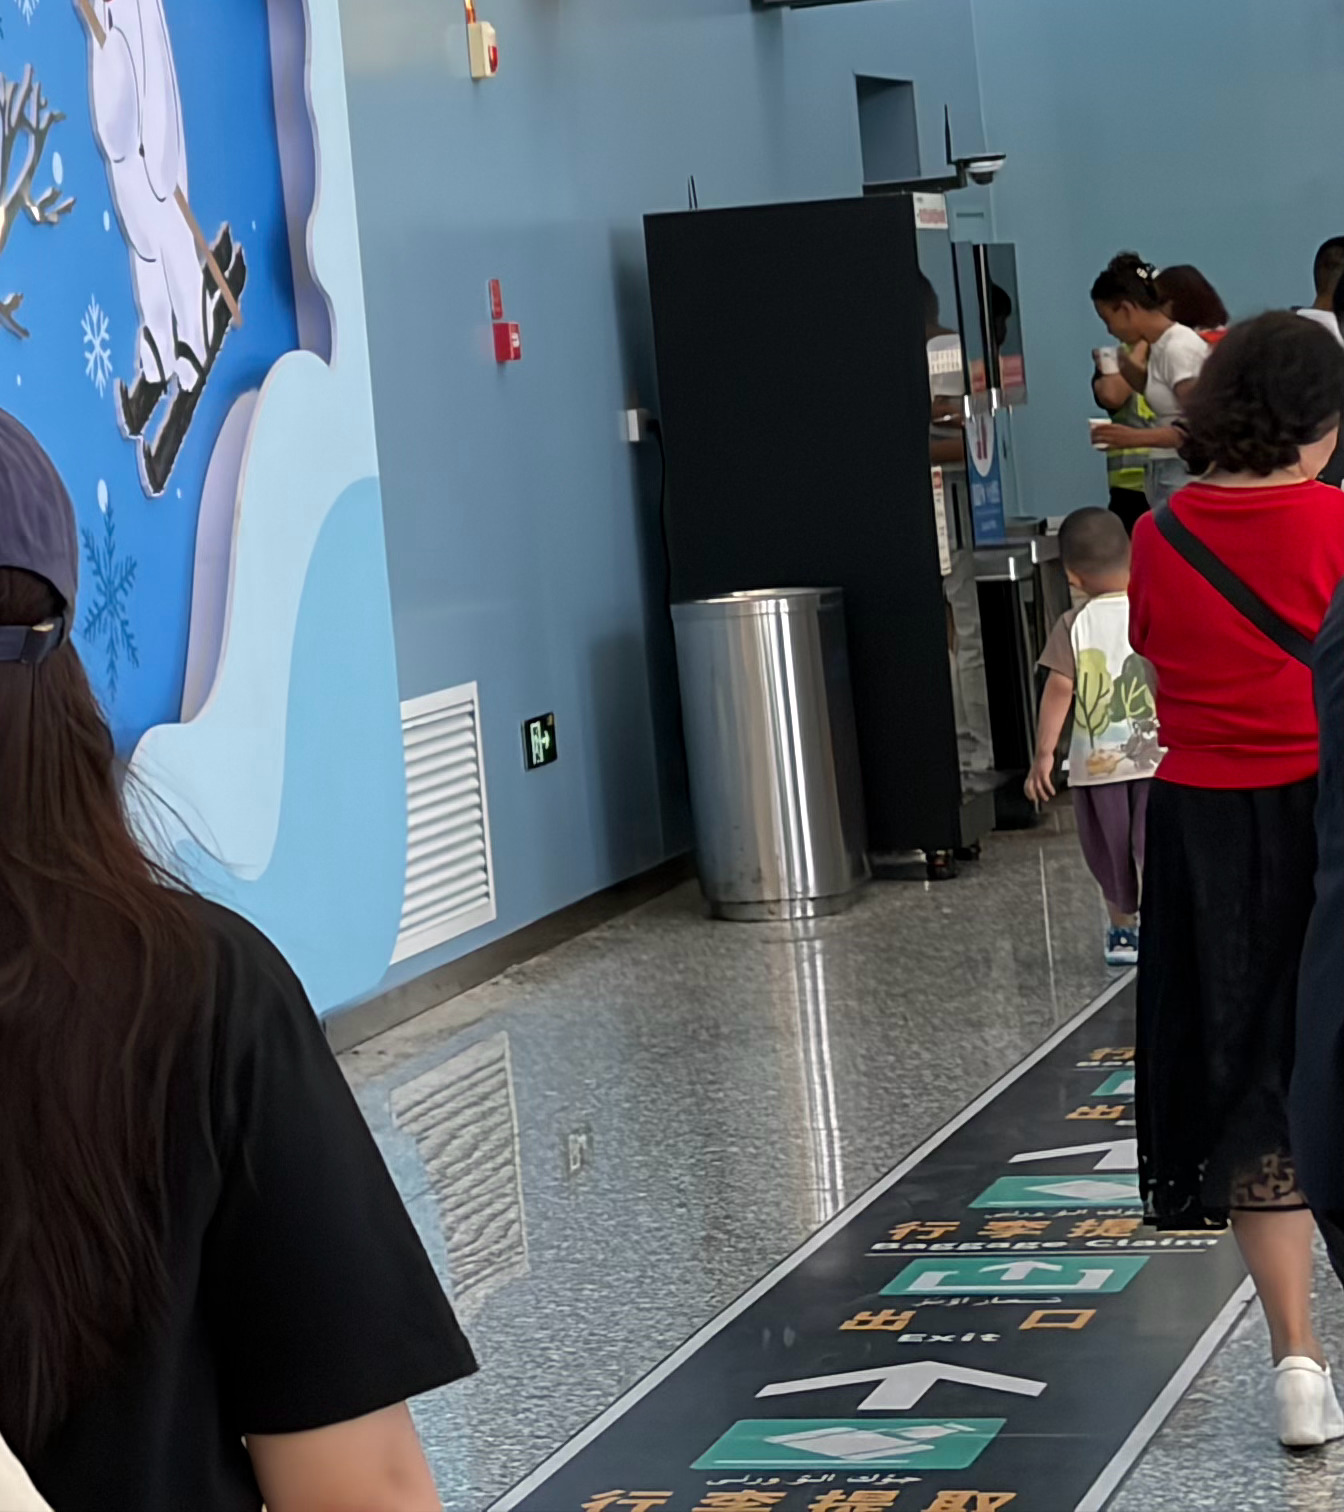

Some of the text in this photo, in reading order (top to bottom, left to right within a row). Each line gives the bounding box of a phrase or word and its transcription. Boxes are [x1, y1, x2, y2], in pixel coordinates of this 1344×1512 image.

[888, 1217, 1227, 1241] 行李提
[870, 1237, 1219, 1251] Baggage Claim
[896, 1331, 1001, 1344] Exit
